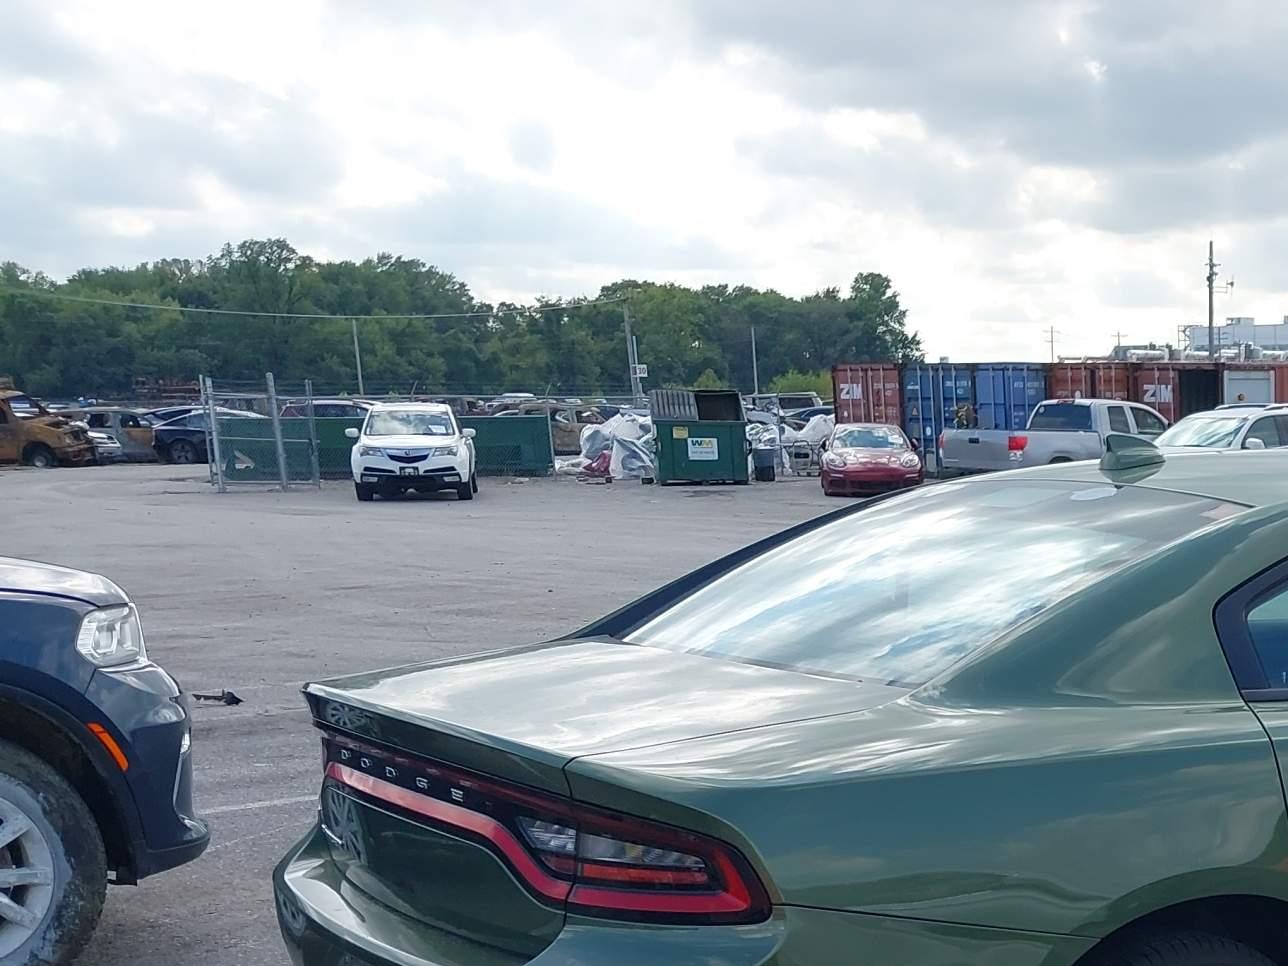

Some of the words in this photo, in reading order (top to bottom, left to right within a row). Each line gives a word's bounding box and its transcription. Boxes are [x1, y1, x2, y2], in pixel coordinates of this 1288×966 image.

[840, 384, 862, 399] ZIM
[1143, 384, 1173, 402] ZIM
[340, 749, 464, 802] DODGE
